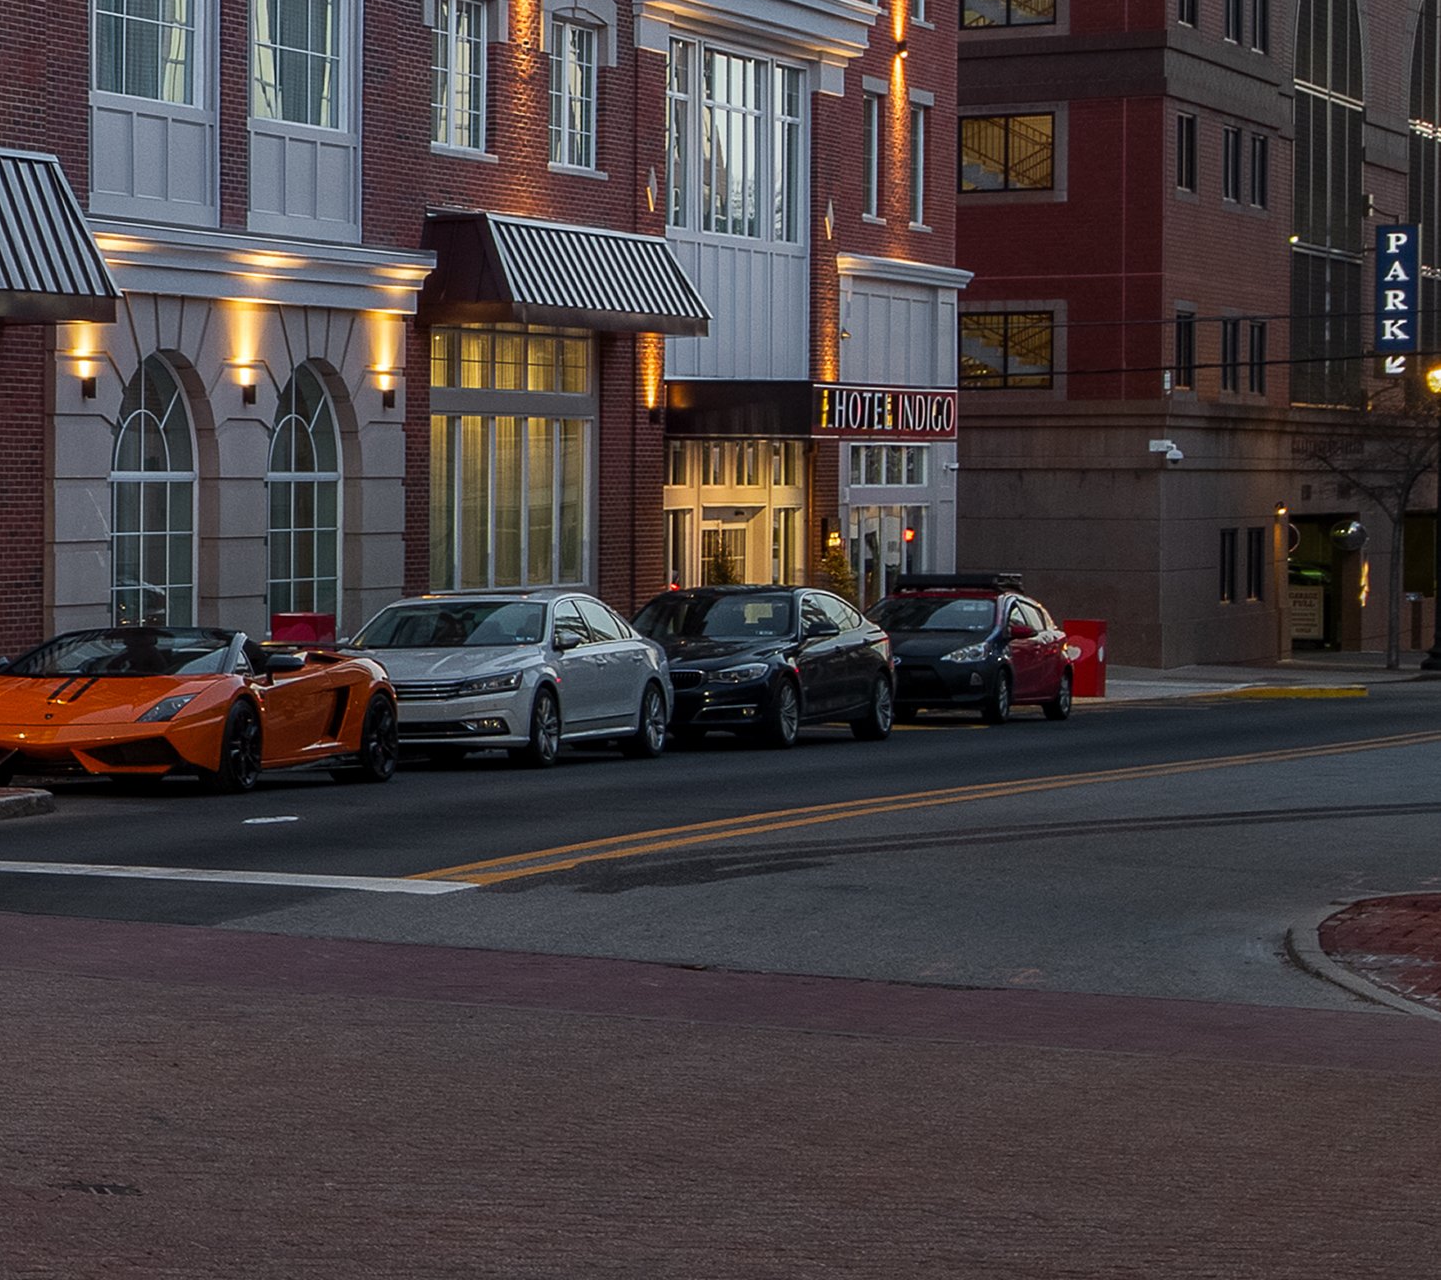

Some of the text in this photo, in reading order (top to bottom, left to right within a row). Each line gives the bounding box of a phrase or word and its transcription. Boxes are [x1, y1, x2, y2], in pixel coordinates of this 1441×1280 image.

[1381, 232, 1410, 340] PARK
[834, 389, 955, 432] HOTEL INDIGO
